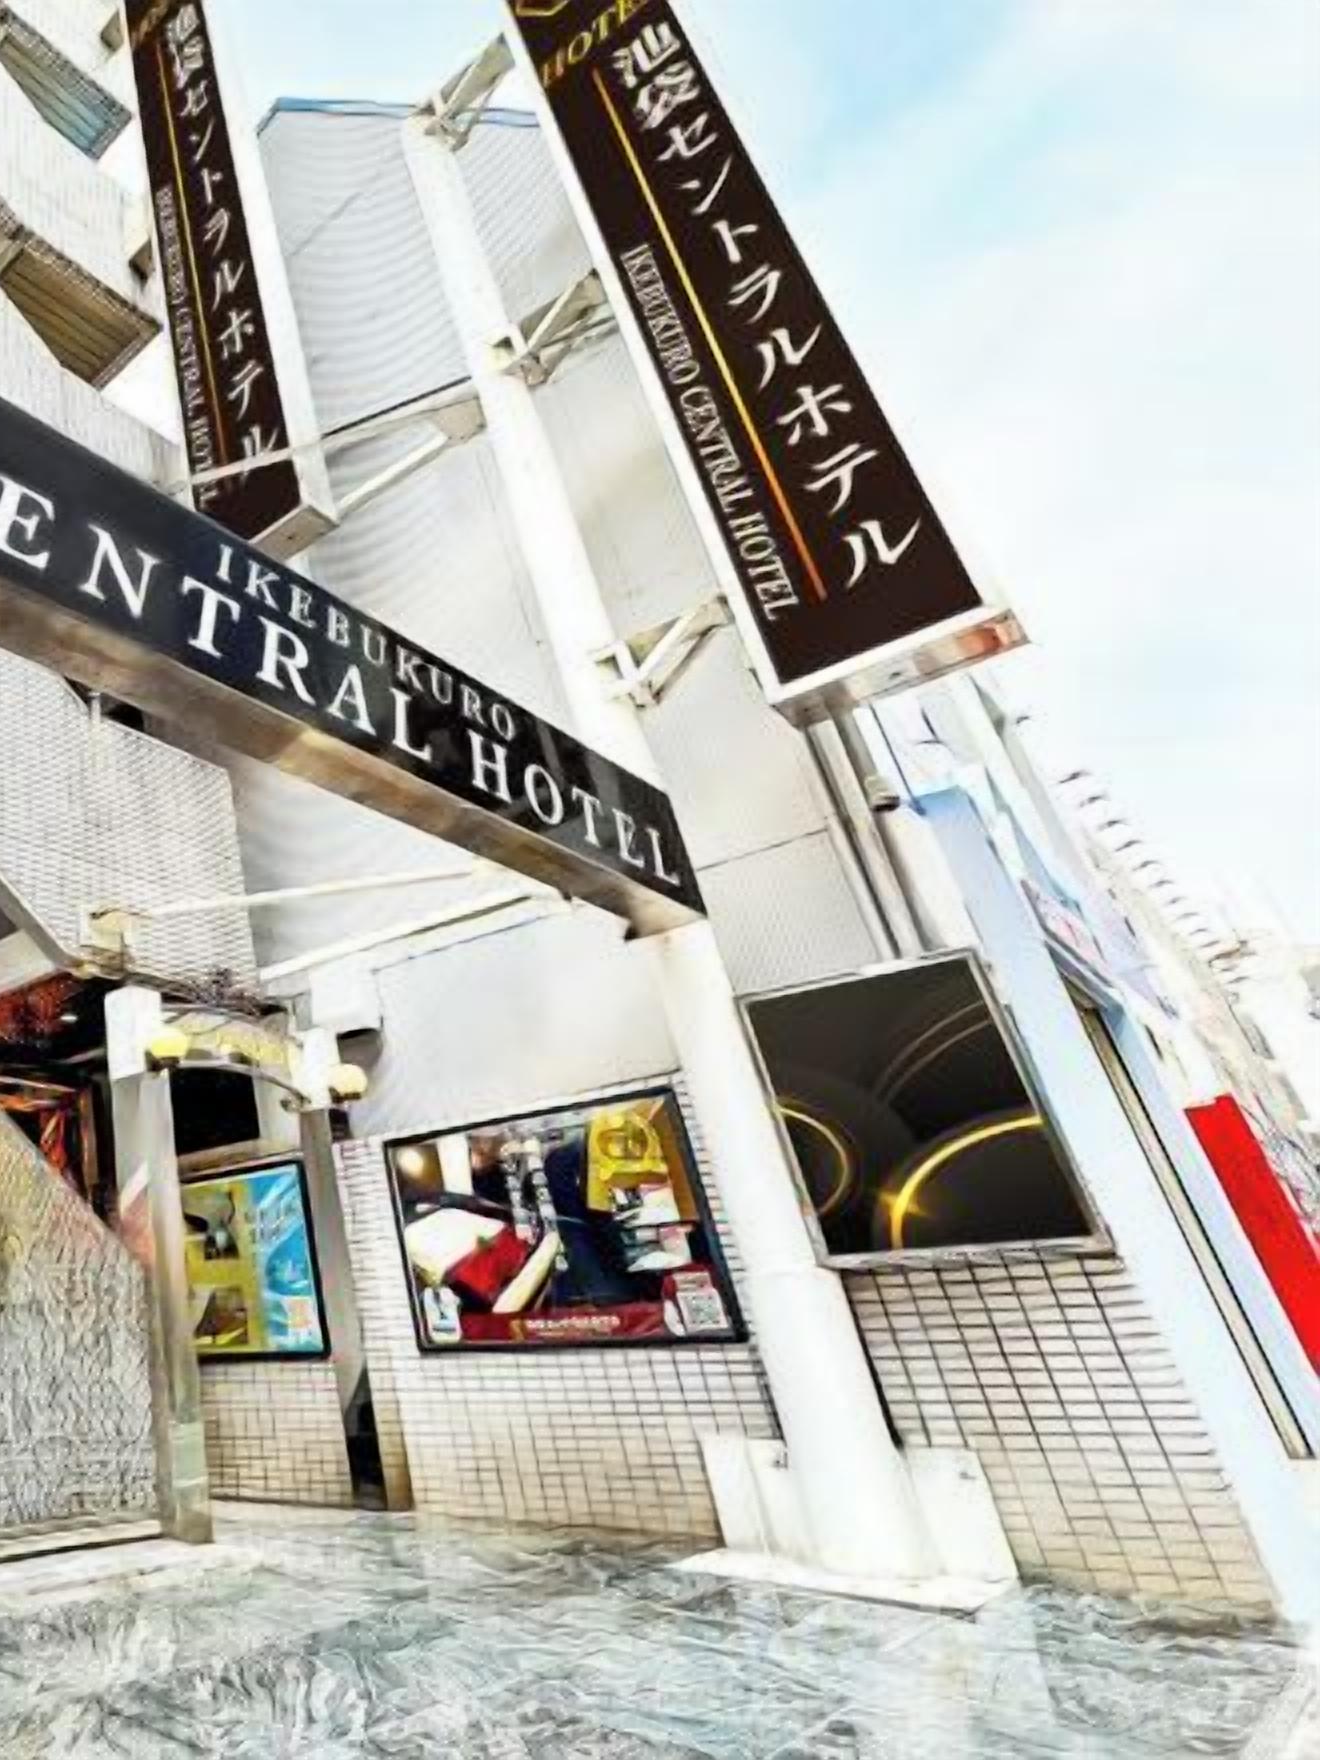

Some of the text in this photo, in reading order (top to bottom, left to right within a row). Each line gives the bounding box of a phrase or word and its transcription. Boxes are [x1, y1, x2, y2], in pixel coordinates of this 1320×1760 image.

[611, 20, 922, 588] 池袋セントラルホテル
[680, 385, 755, 512] CENTRAL
[728, 511, 800, 621] HOTEL
[215, 543, 516, 742] IKEBUKURO
[469, 731, 679, 886] HOTEL
